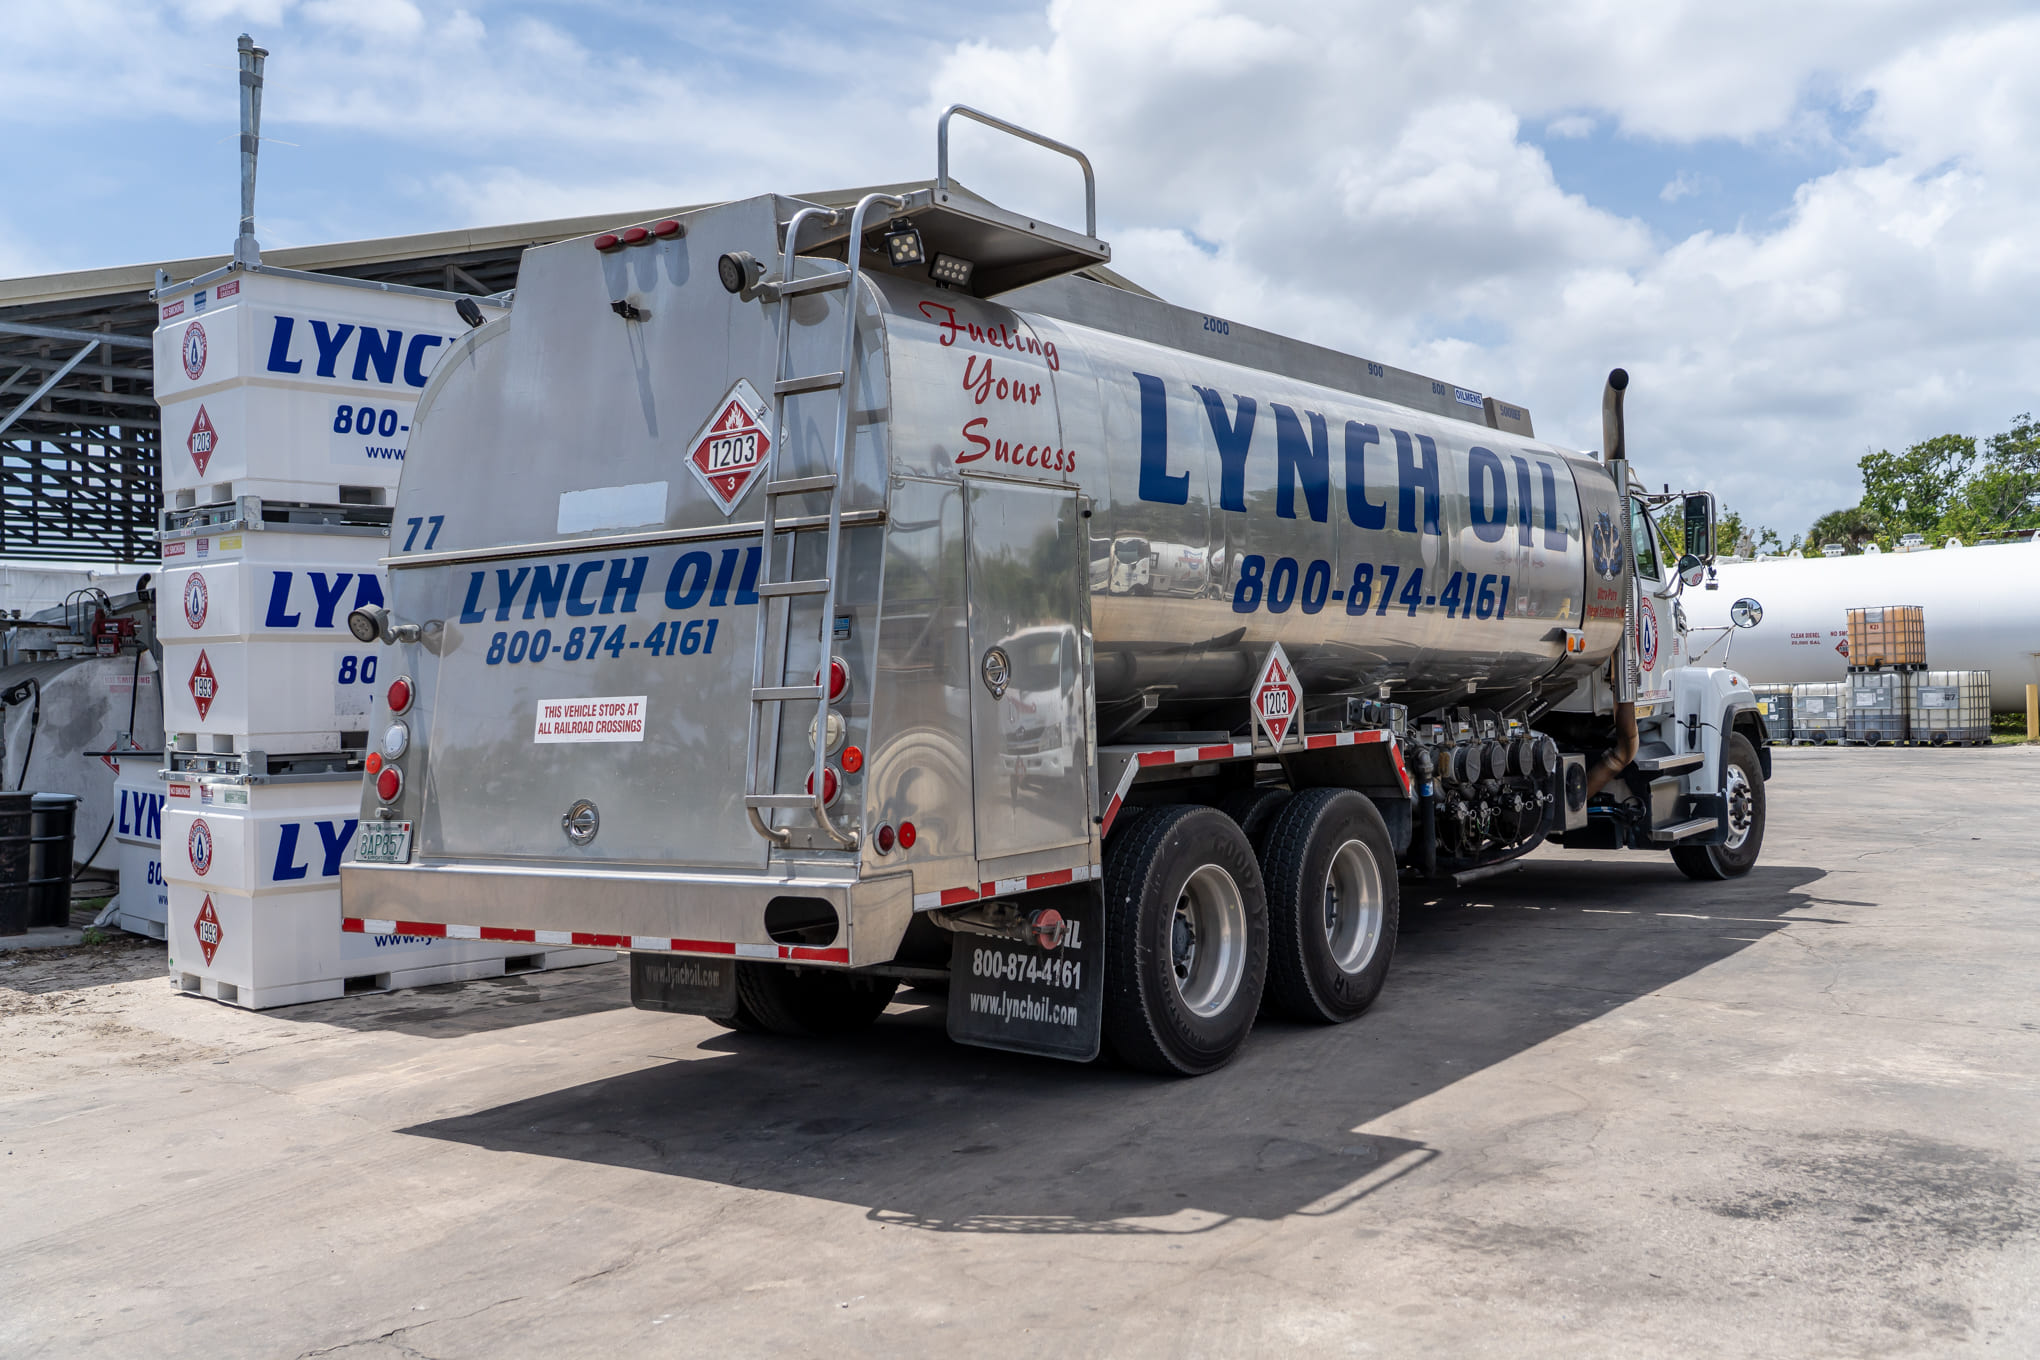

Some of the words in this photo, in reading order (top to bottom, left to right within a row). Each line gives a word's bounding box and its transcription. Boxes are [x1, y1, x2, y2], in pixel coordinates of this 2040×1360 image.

[918, 300, 1060, 372] Fueling
[1203, 316, 1230, 336] 2000
[267, 315, 456, 388] LYNC
[962, 354, 1042, 406] Your
[1367, 362, 1384, 378] 900
[1455, 389, 1482, 405] OILMENS
[333, 404, 410, 438] 800-
[192, 432, 211, 452] 1203
[712, 435, 755, 468] 1203
[955, 416, 1076, 473] Success
[199, 458, 204, 469] 3
[1132, 371, 1442, 537] LYNCH
[1467, 446, 1569, 553] OIL
[727, 476, 736, 490] 3
[402, 514, 445, 552] 77
[459, 556, 649, 624] LYNCH
[664, 546, 763, 610] OIL
[1231, 554, 1511, 621] 800-874-4161
[485, 618, 719, 665] 800-874-4161
[195, 677, 212, 698] 1993
[544, 705, 562, 719] THIS
[564, 704, 597, 718] VEHICLE
[598, 703, 626, 717] STOPS
[626, 702, 639, 716] AT
[1264, 691, 1288, 715] 1203
[537, 722, 552, 735] ALL
[553, 721, 594, 734] RAILROAD
[595, 719, 642, 734] CROSSINGS
[1274, 722, 1280, 735] 3
[360, 833, 405, 857] 8AP857
[200, 921, 217, 944] 1993
[645, 960, 720, 990] www.lynchoil.com
[972, 947, 1081, 990] 800-874-4161
[970, 990, 1078, 1027] www.lynchoil.com
